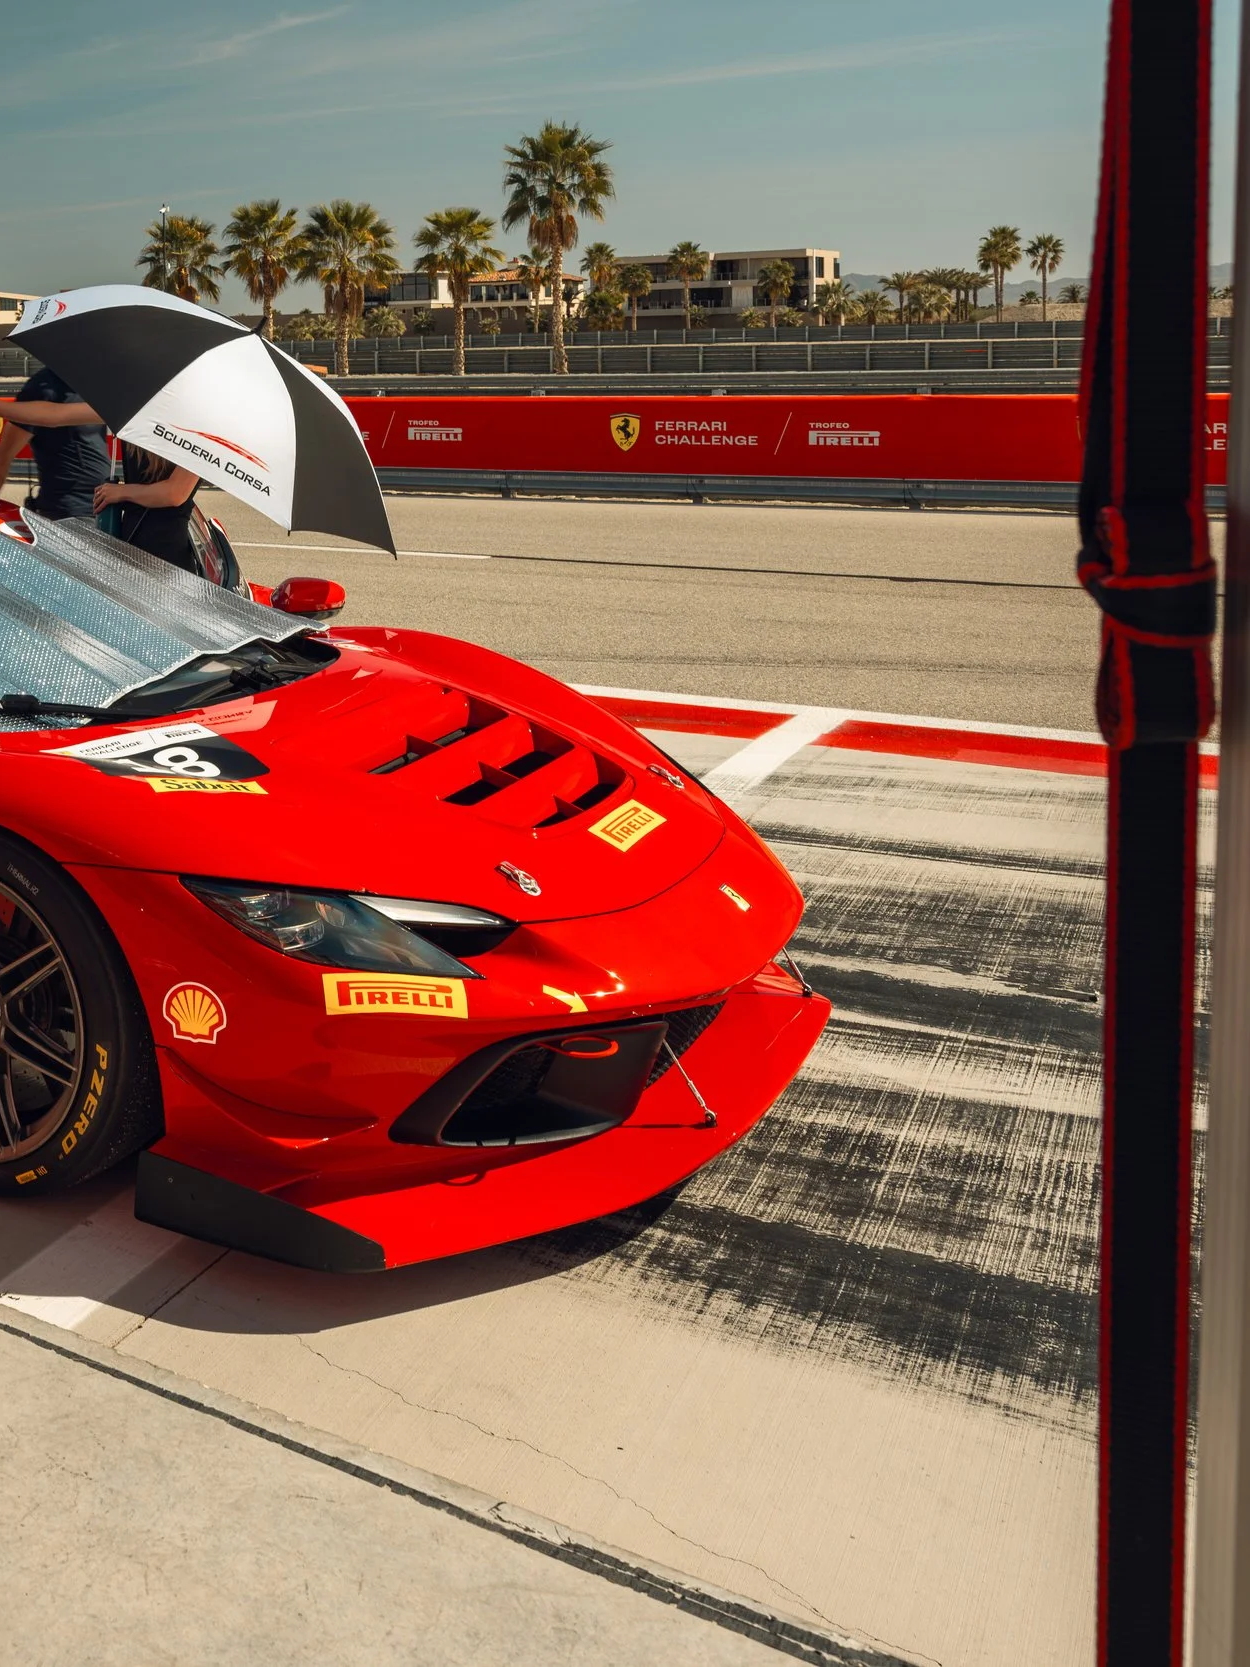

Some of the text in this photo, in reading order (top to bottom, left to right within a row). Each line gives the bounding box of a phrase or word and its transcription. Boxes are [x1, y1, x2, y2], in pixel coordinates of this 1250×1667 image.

[655, 421, 727, 431] FERRARI
[408, 427, 463, 441] PIRELLI
[655, 434, 758, 446] CHALLENGE
[808, 430, 881, 446] PIRELLI
[600, 806, 655, 843] PIRELLI
[336, 980, 454, 1009] PIRELLI
